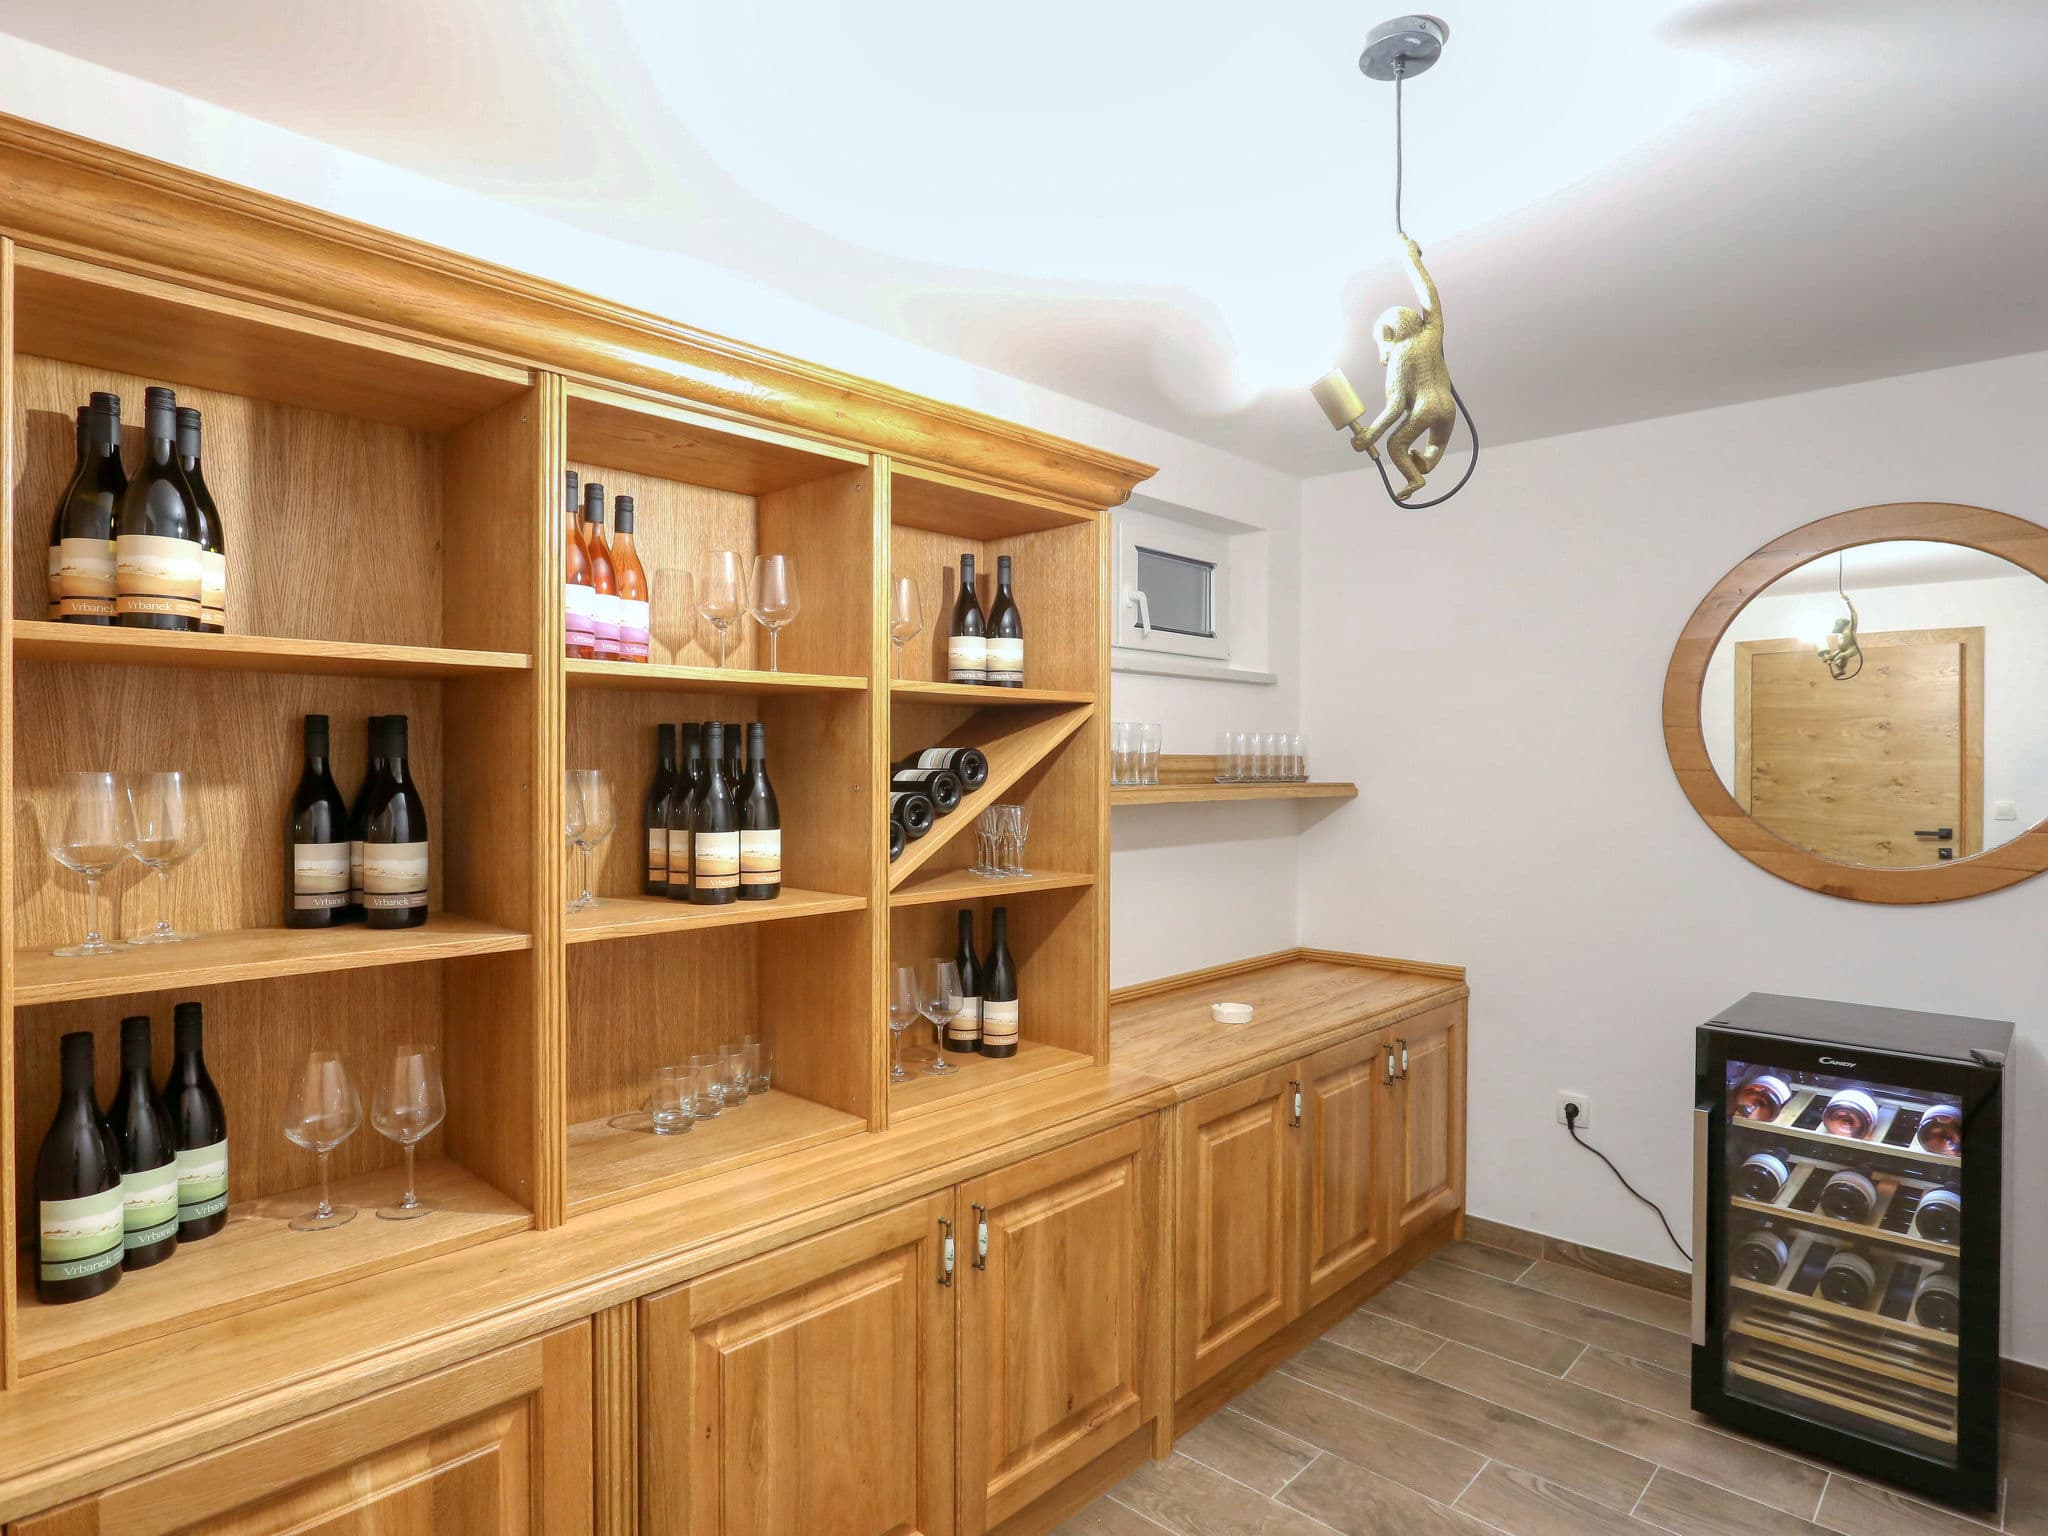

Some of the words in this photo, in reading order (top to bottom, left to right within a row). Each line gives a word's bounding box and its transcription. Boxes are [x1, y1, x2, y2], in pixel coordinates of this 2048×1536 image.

[127, 600, 172, 611] Vrbanek
[373, 897, 409, 906] Vrbanek
[64, 1256, 112, 1276] Vrbanek
